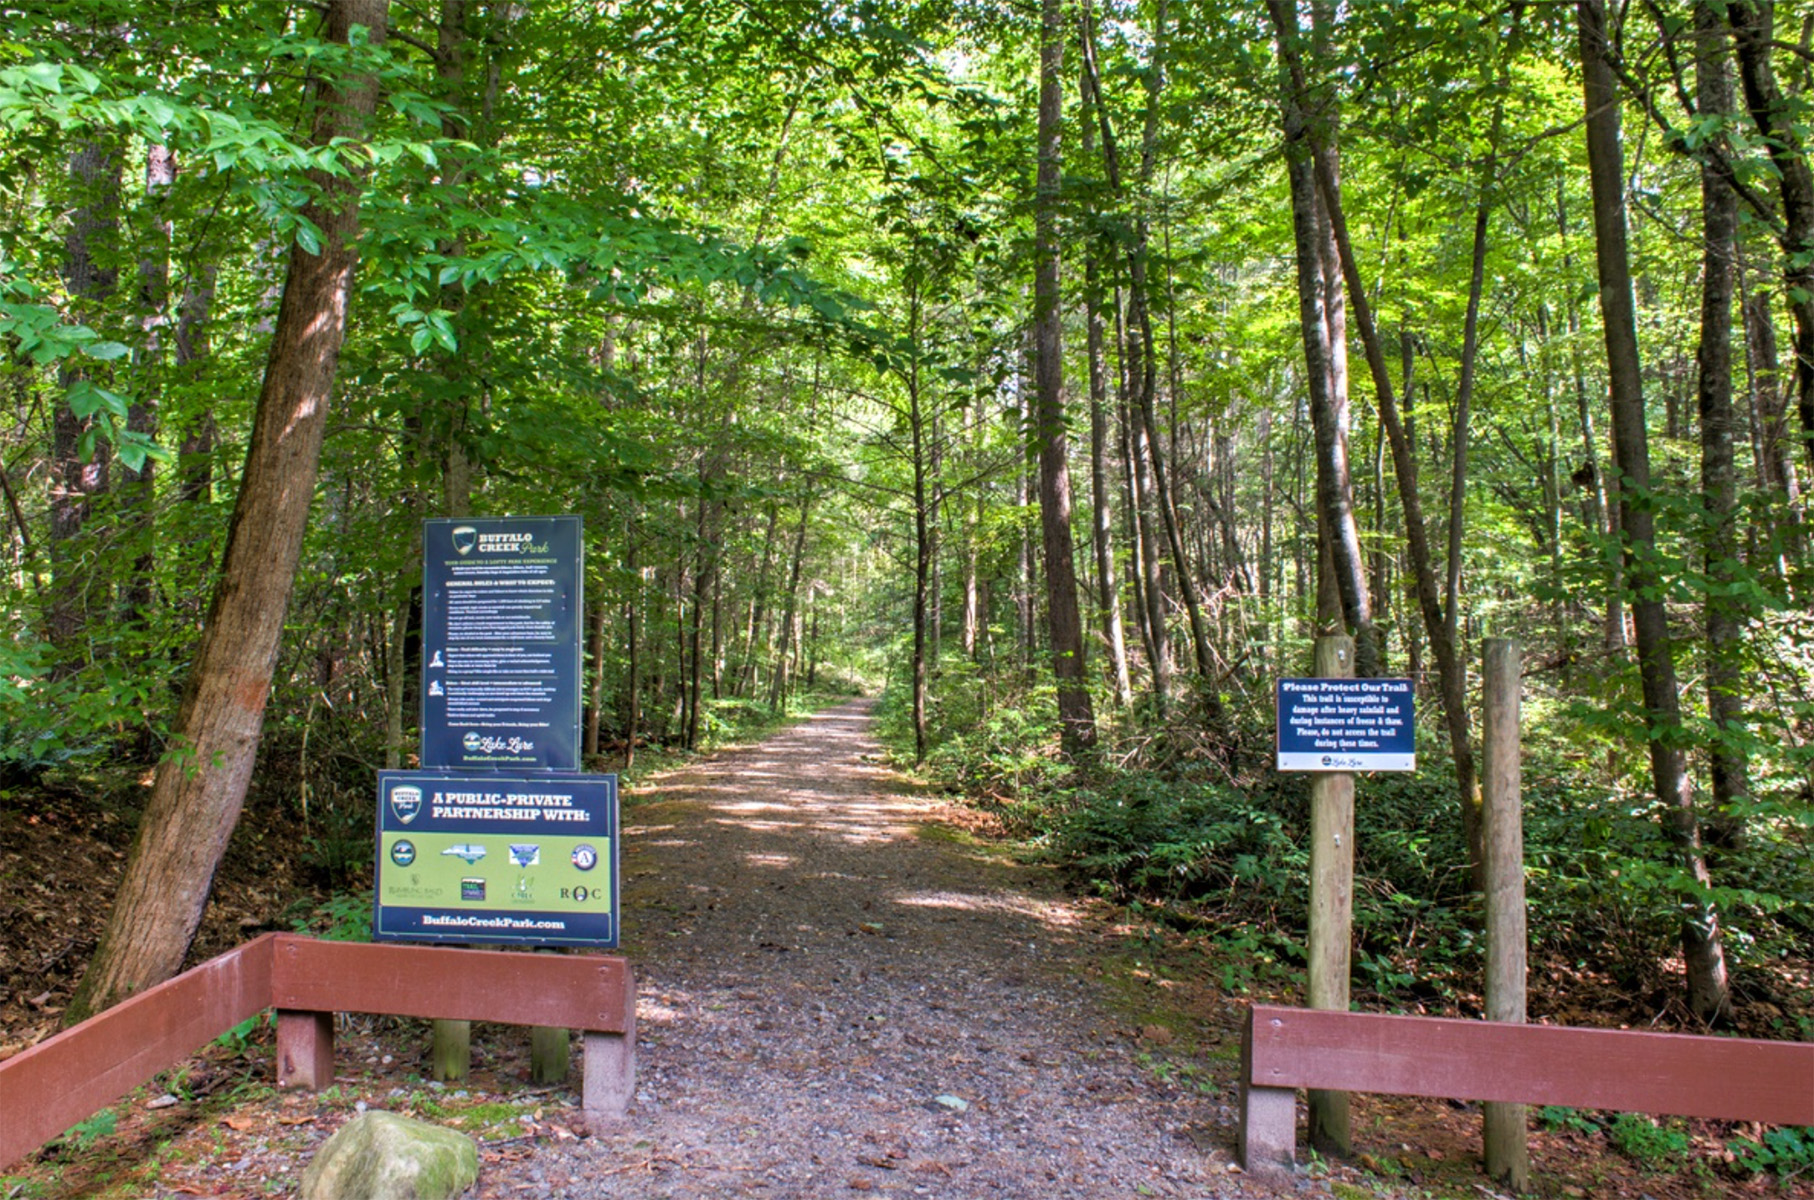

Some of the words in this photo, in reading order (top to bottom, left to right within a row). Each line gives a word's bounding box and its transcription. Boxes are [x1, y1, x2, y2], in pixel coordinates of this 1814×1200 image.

[479, 533, 533, 543] BUFFALO
[478, 543, 520, 552] CREEK
[520, 541, 549, 554] Park
[1282, 683, 1319, 692] Please
[1320, 683, 1360, 692] Protect
[1361, 683, 1381, 692] Our
[1302, 694, 1318, 703] This
[1319, 694, 1334, 703] trail
[1335, 694, 1342, 703] is
[1343, 694, 1380, 705] susceptible
[1381, 695, 1389, 703] to
[1292, 705, 1319, 716] damage
[1320, 705, 1337, 714] after
[1338, 705, 1358, 716] heavy
[1359, 705, 1385, 714] rainfall
[1386, 705, 1400, 714] and
[1289, 717, 1313, 727] during
[1314, 717, 1345, 725] instances
[1347, 717, 1355, 725] of
[1356, 717, 1375, 725] freeze
[1377, 717, 1384, 725] &
[1296, 728, 1321, 738] Please,
[1321, 728, 1330, 736] do
[1331, 728, 1343, 736] not
[1345, 728, 1367, 736] access
[1367, 728, 1379, 736] the
[1380, 728, 1396, 737] trail
[479, 736, 507, 754] Lake
[507, 736, 534, 754] Lure
[1314, 739, 1337, 749] during
[1338, 739, 1357, 748] these
[1358, 739, 1380, 748] times.
[463, 755, 537, 763] BuffaloCreekPark.com
[432, 792, 445, 804] A
[445, 793, 573, 806] PUBLIC-PRIVATE
[432, 807, 541, 820] PARTNERSHIP
[543, 809, 591, 822] WITH:
[422, 915, 567, 930] BuffaloCreekPark.com
